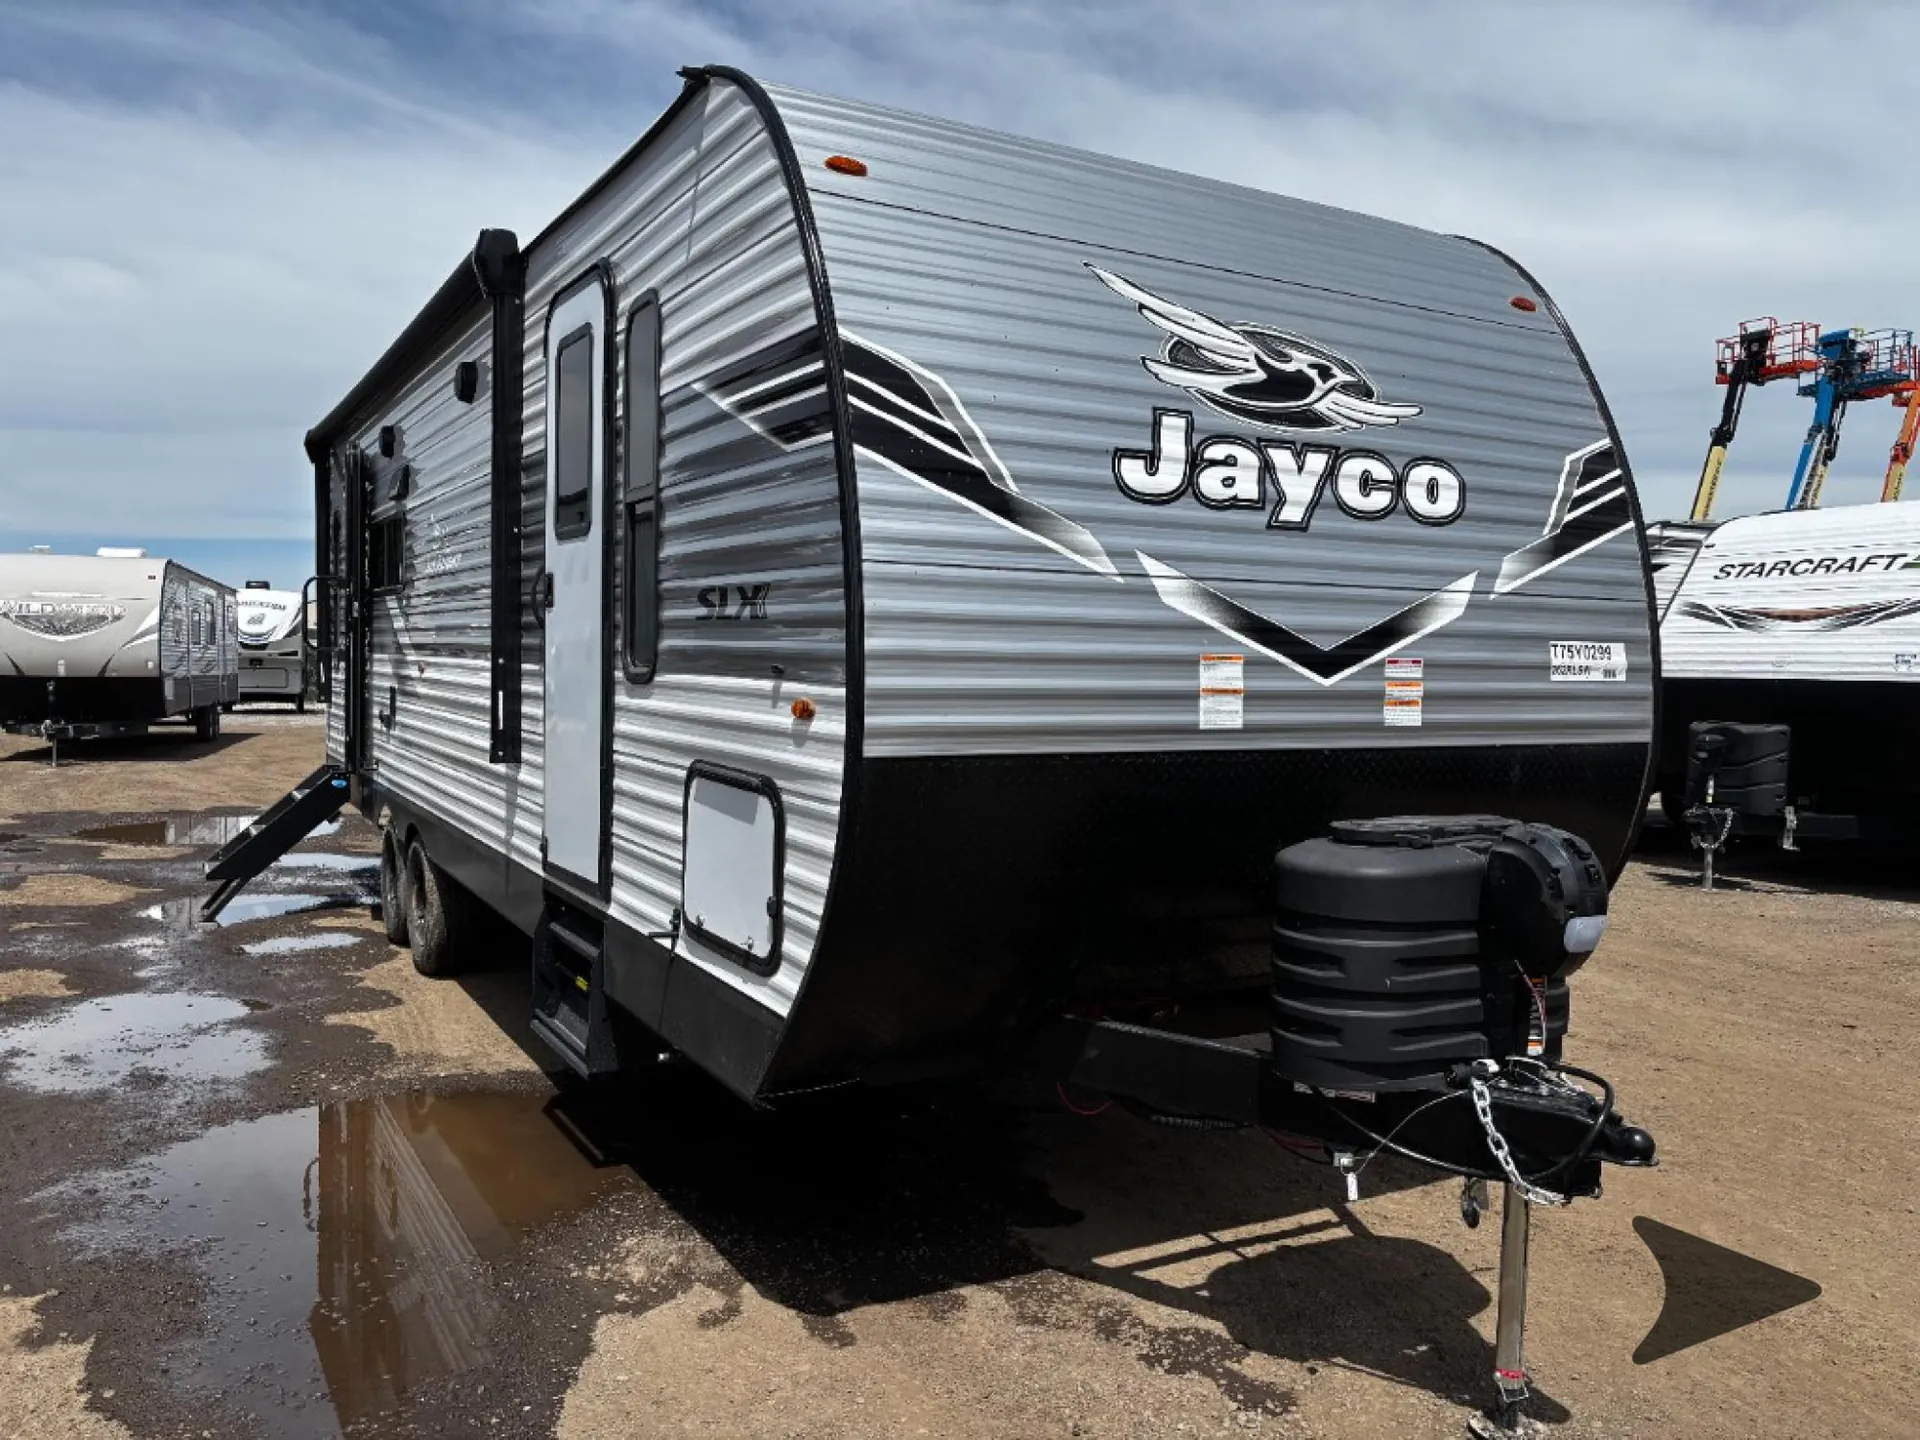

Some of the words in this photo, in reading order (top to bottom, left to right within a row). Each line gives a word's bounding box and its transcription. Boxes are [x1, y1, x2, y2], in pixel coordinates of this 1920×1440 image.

[1111, 406, 1467, 532] Jayco
[1713, 553, 1908, 580] STARCRAFT
[695, 582, 772, 620] SLX
